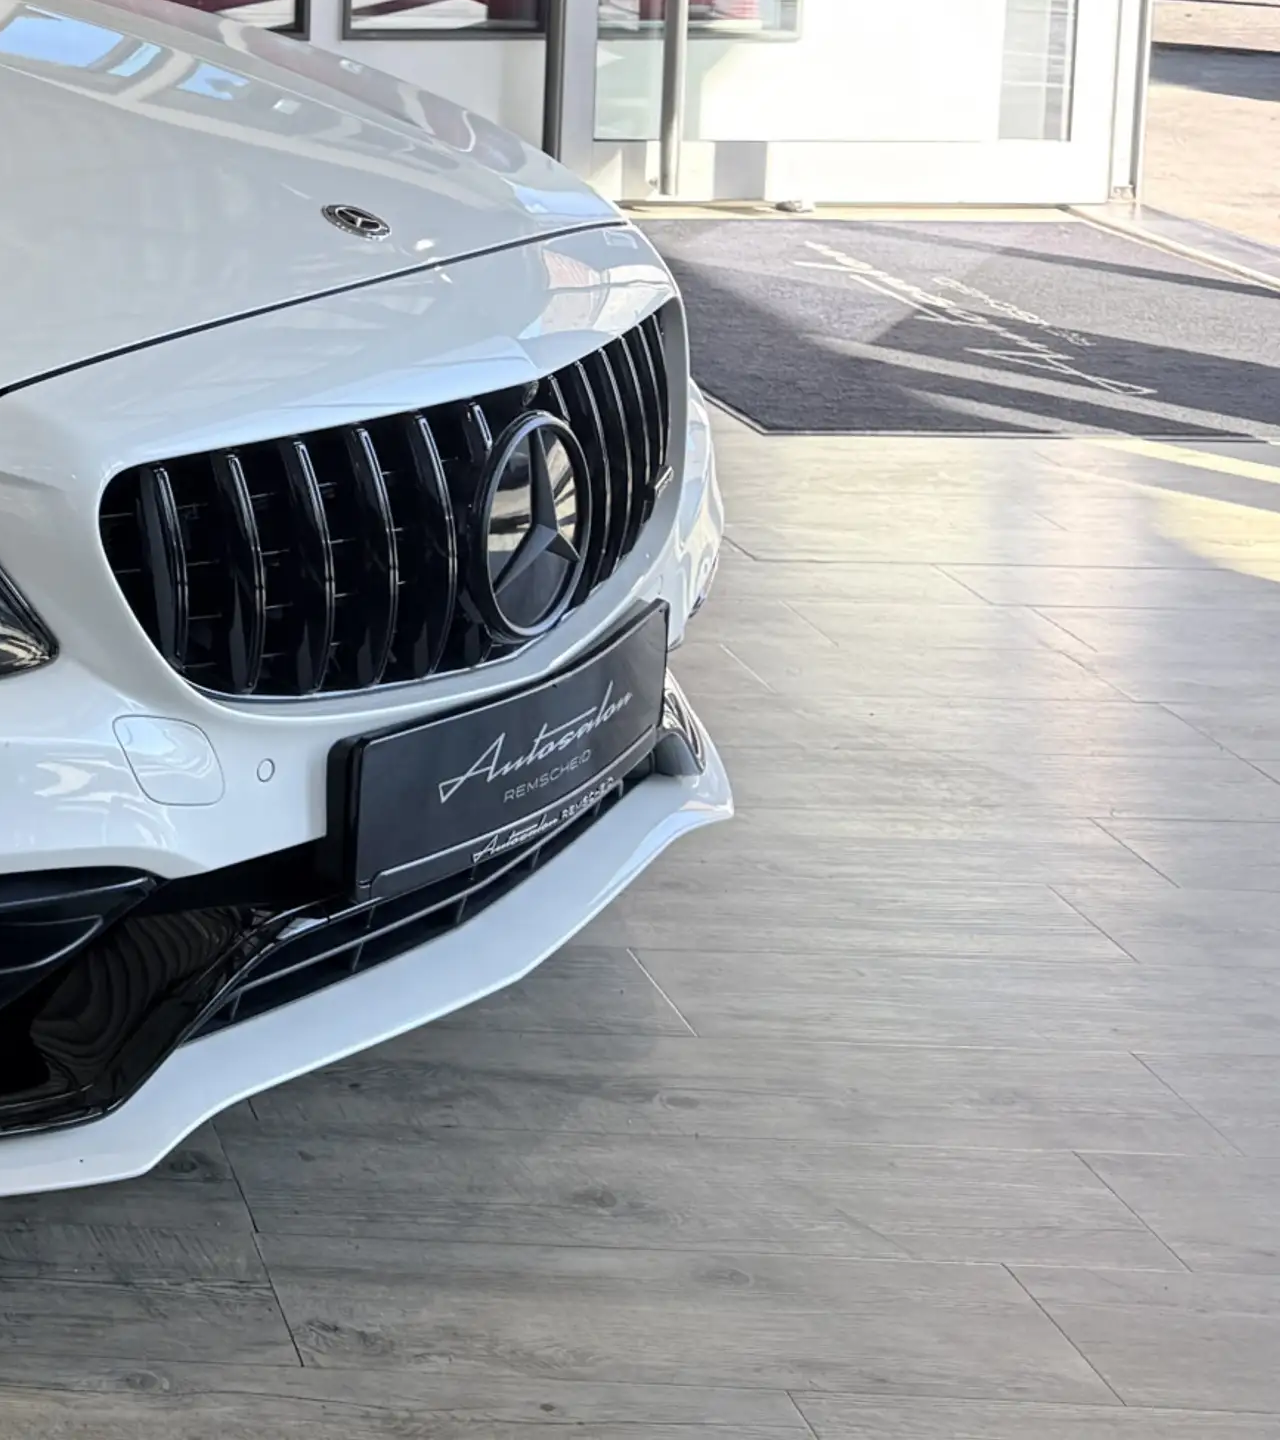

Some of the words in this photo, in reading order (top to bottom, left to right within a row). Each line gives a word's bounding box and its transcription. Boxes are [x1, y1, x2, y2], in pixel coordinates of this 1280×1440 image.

[439, 680, 633, 803] Autosalon
[502, 749, 592, 803] REMSCHEID
[473, 815, 558, 863] Autosalon
